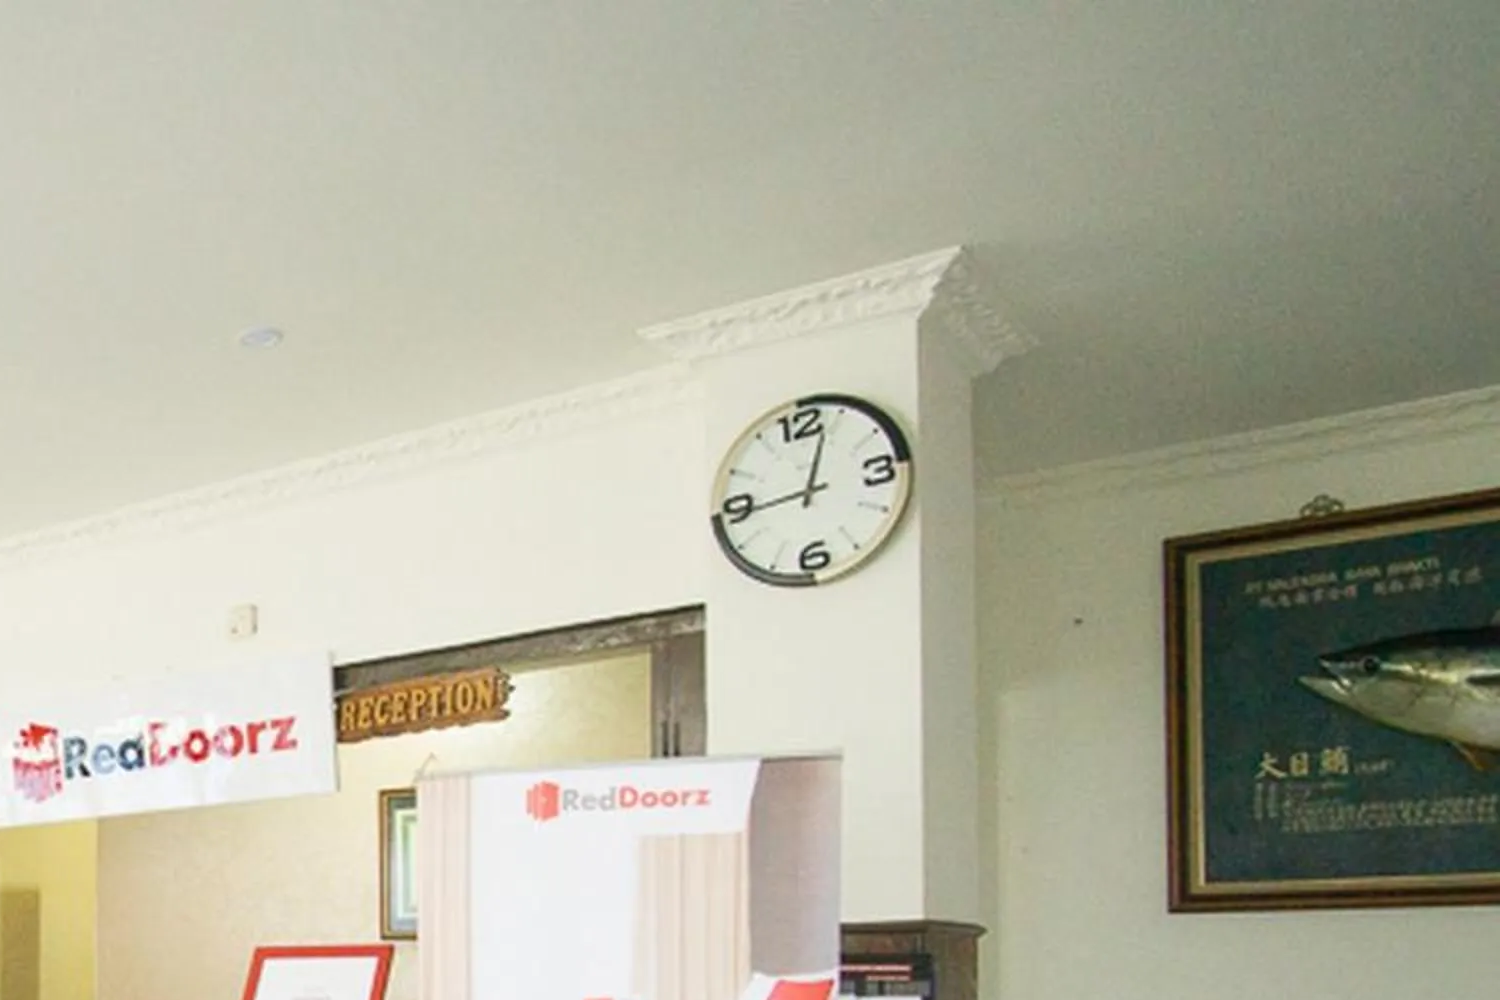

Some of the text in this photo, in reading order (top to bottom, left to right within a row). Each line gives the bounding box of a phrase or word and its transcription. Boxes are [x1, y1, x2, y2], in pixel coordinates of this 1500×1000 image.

[778, 408, 824, 442] 12
[862, 454, 896, 487] 3
[723, 493, 754, 524] 9
[799, 540, 831, 570] 6
[340, 674, 495, 732] RECEPTION
[562, 786, 710, 812] RedDoorz
